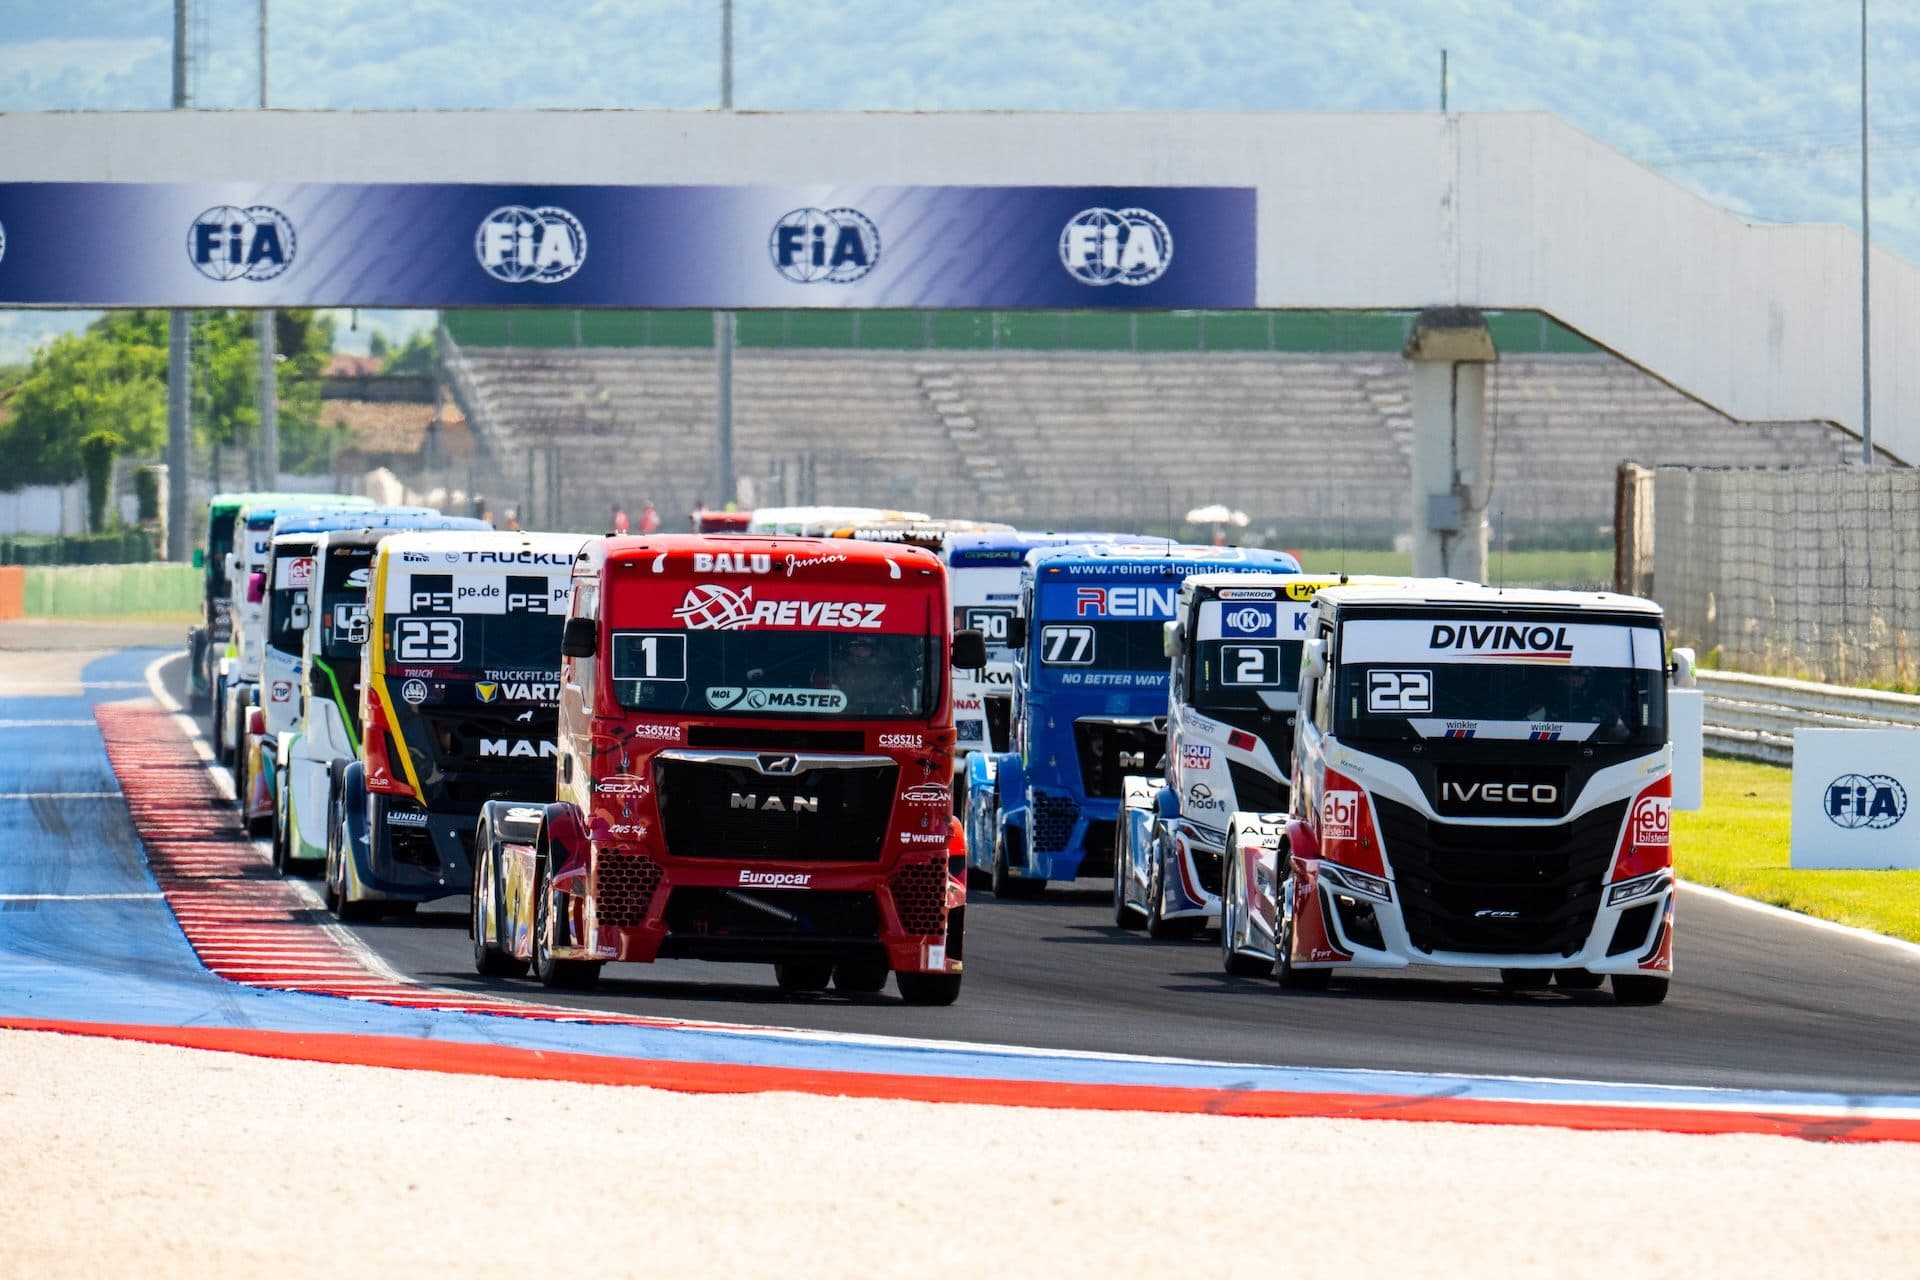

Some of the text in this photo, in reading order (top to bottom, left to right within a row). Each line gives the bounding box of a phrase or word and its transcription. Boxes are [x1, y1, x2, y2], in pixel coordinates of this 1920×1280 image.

[694, 552, 847, 577] BALU Junior
[413, 592, 453, 611] PE
[458, 584, 500, 600] pe.de
[1077, 587, 1177, 616] REIN
[508, 593, 548, 613] PE
[972, 616, 1007, 638] 30
[401, 622, 458, 658] 23
[1045, 629, 1091, 661] 77
[1430, 625, 1573, 651] DIVINOL
[640, 637, 657, 676] 1
[1237, 649, 1264, 682] 2
[404, 669, 433, 678] TRUCK
[484, 670, 560, 681] TRUCKFIT.DE
[1062, 673, 1164, 686] NO BETTER WAY
[768, 693, 840, 708] MASTER
[1371, 673, 1430, 710] 22
[1446, 721, 1478, 729] winkler
[1531, 723, 1563, 732] winkler
[1442, 782, 1557, 803] IVECO
[730, 793, 819, 813] MAN
[1640, 832, 1669, 843] bilstein
[739, 869, 812, 888] Europcar
